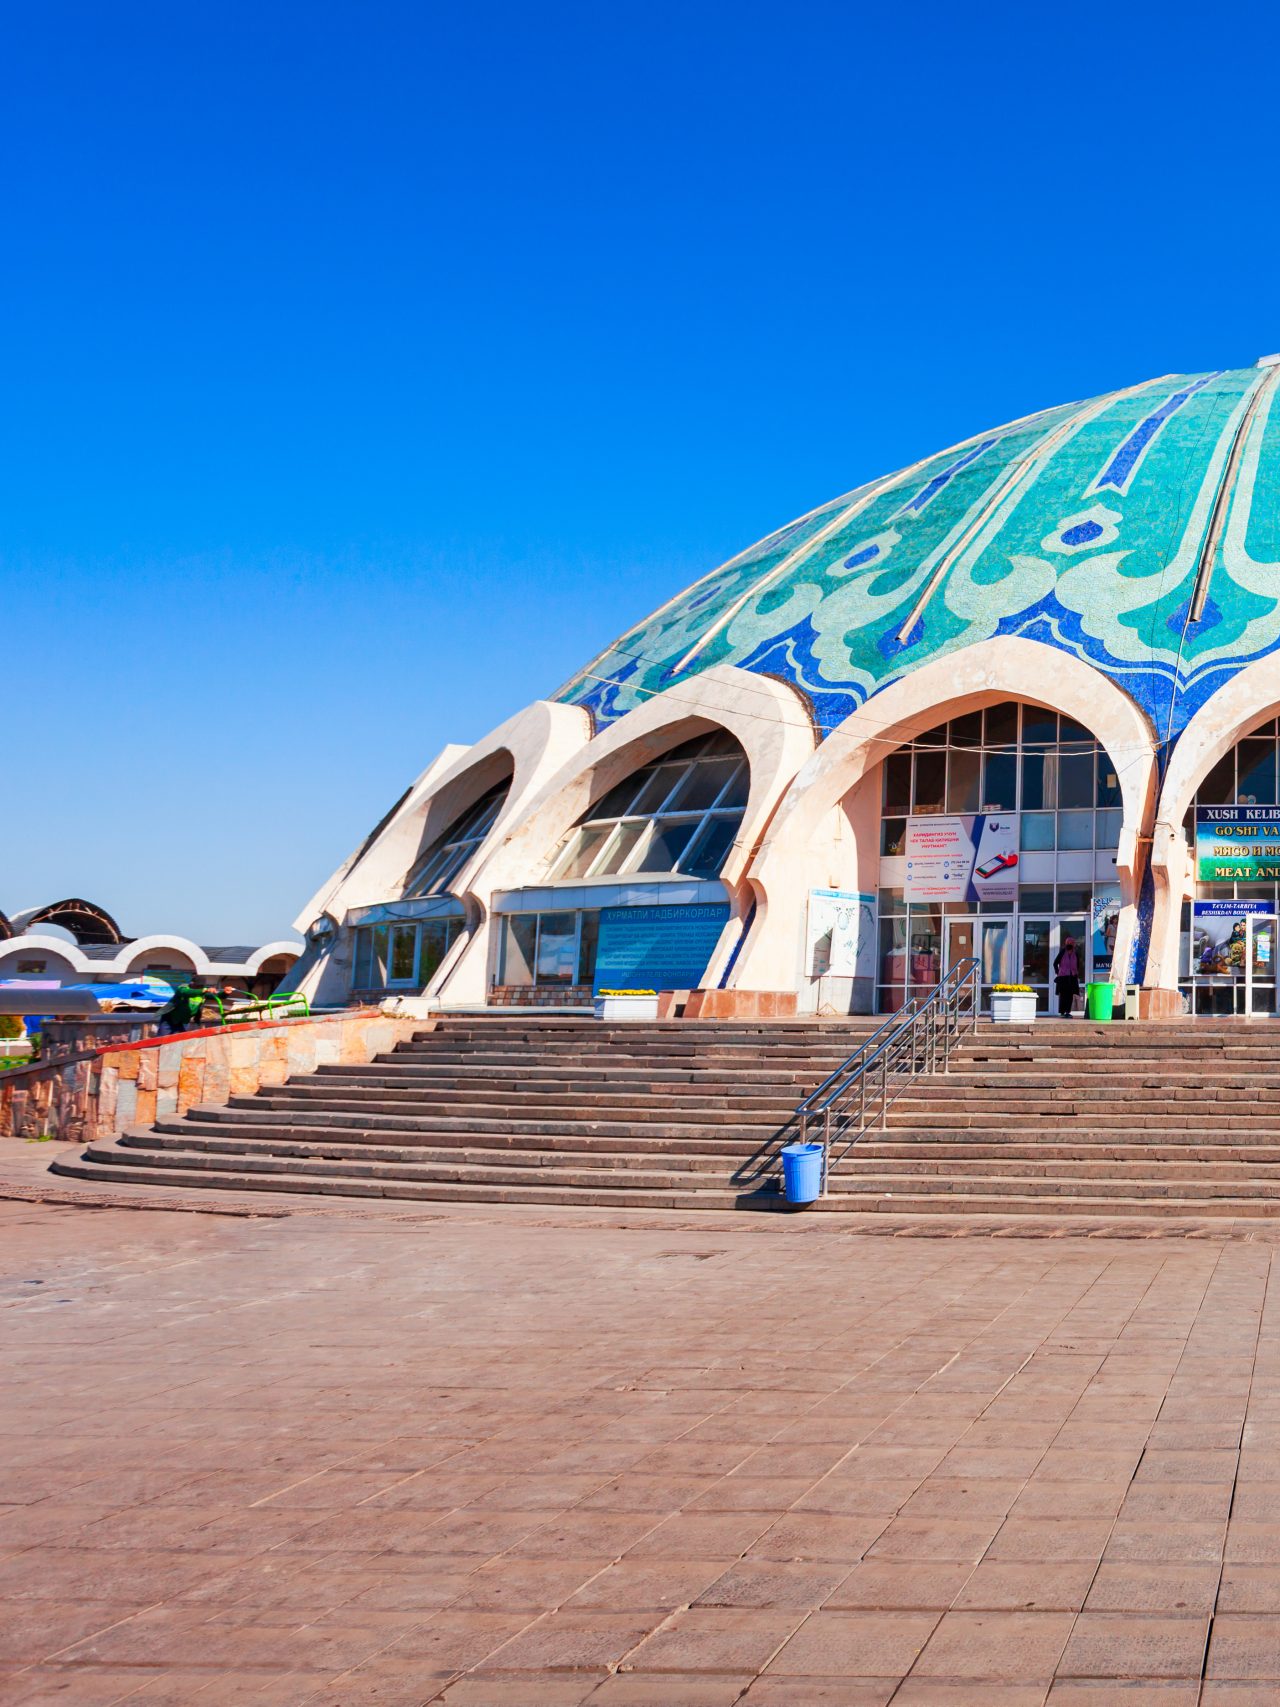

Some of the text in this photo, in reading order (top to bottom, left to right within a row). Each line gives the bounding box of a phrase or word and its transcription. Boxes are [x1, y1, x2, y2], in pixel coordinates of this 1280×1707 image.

[1206, 809, 1239, 820] XUSH
[1263, 826, 1279, 836] VA
[1213, 846, 1249, 857] МЯСО
[1252, 846, 1261, 856] И
[1215, 867, 1252, 877] MEAT
